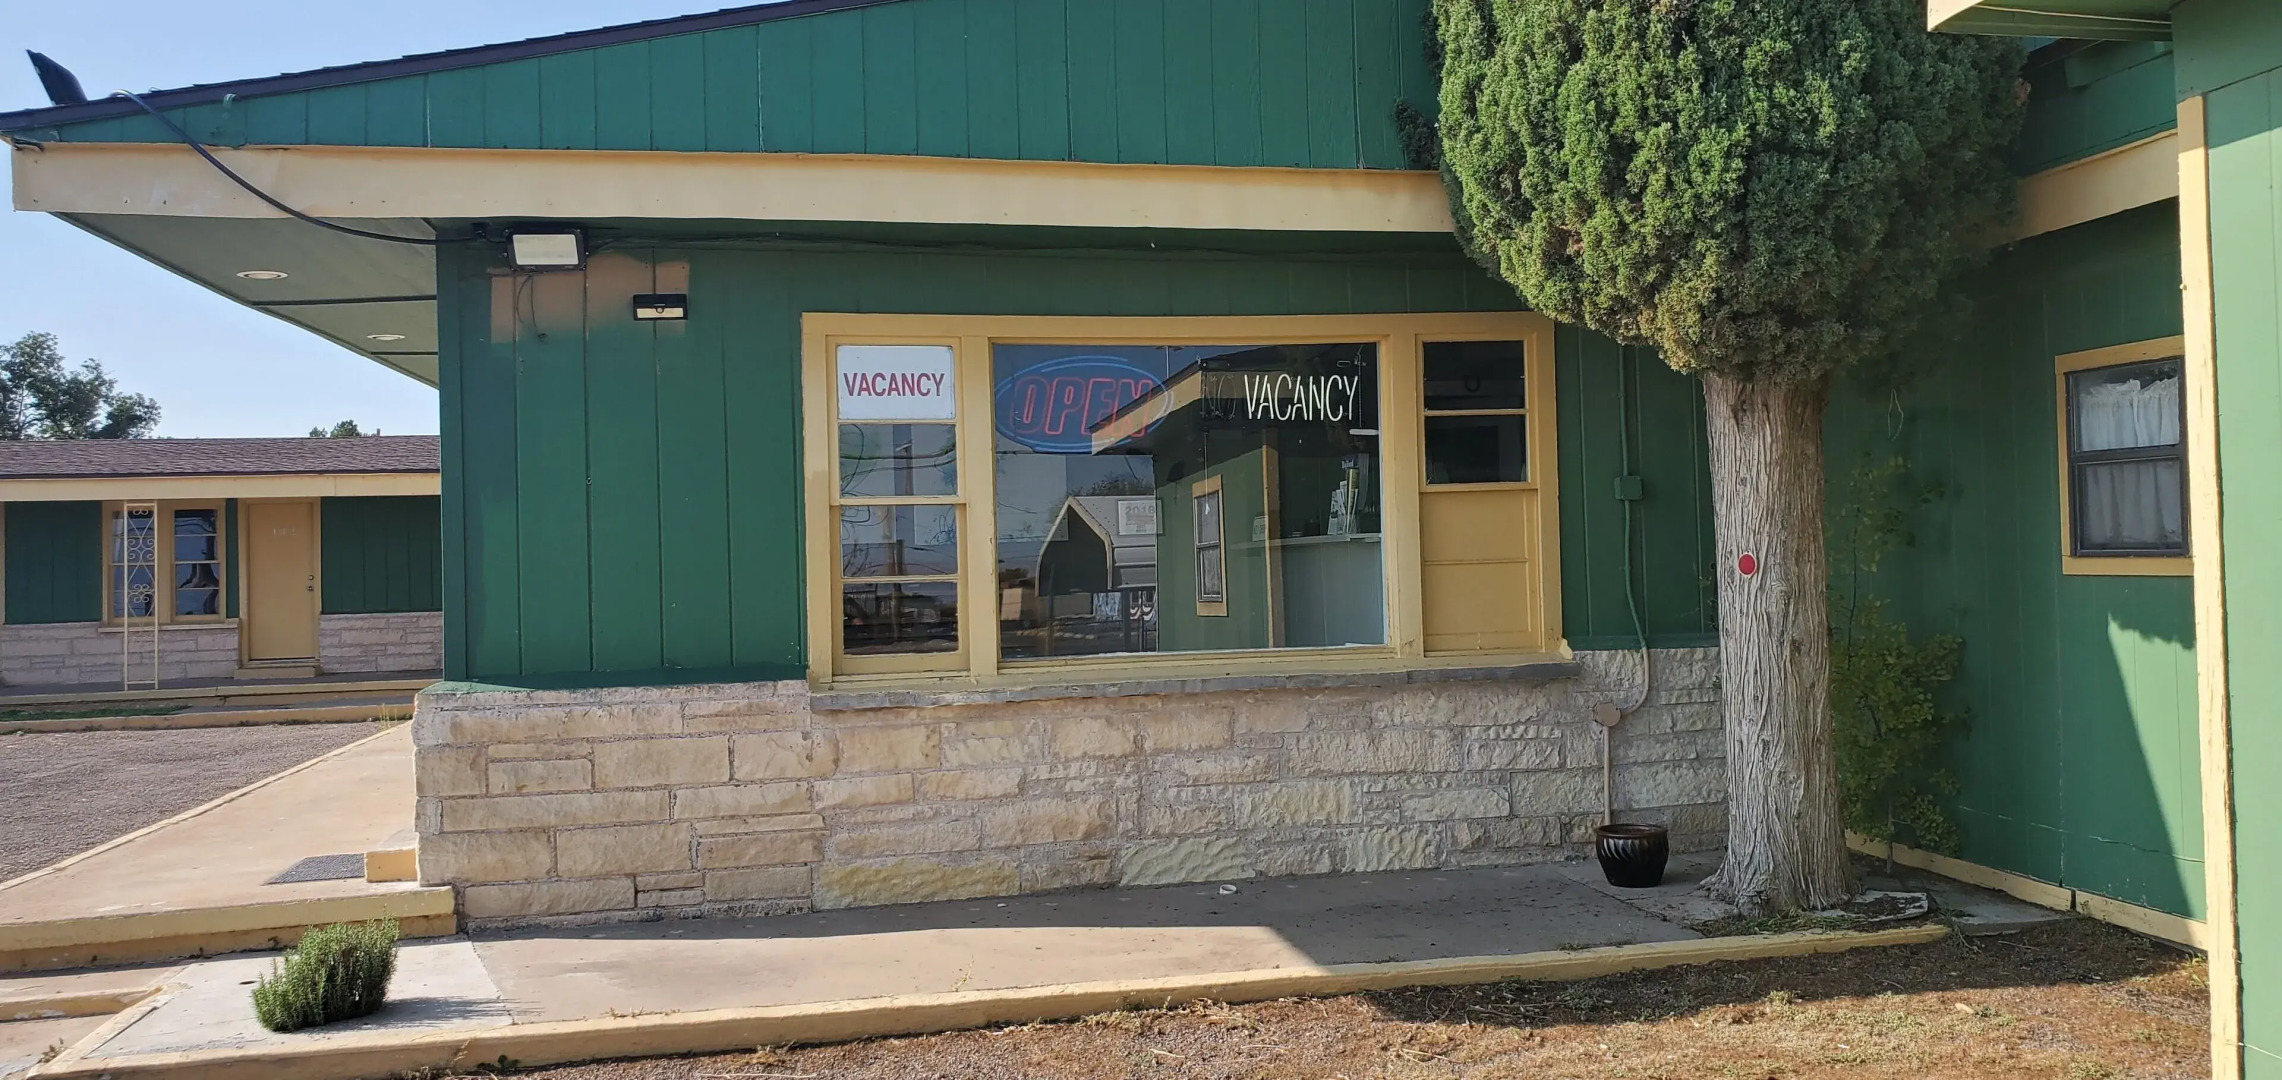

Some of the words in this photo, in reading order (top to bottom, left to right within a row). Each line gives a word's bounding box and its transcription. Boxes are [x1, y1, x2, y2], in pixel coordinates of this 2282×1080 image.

[843, 372, 945, 397] VACANCY
[1009, 376, 1154, 438] OPEN
[1244, 373, 1359, 421] VACANCY
